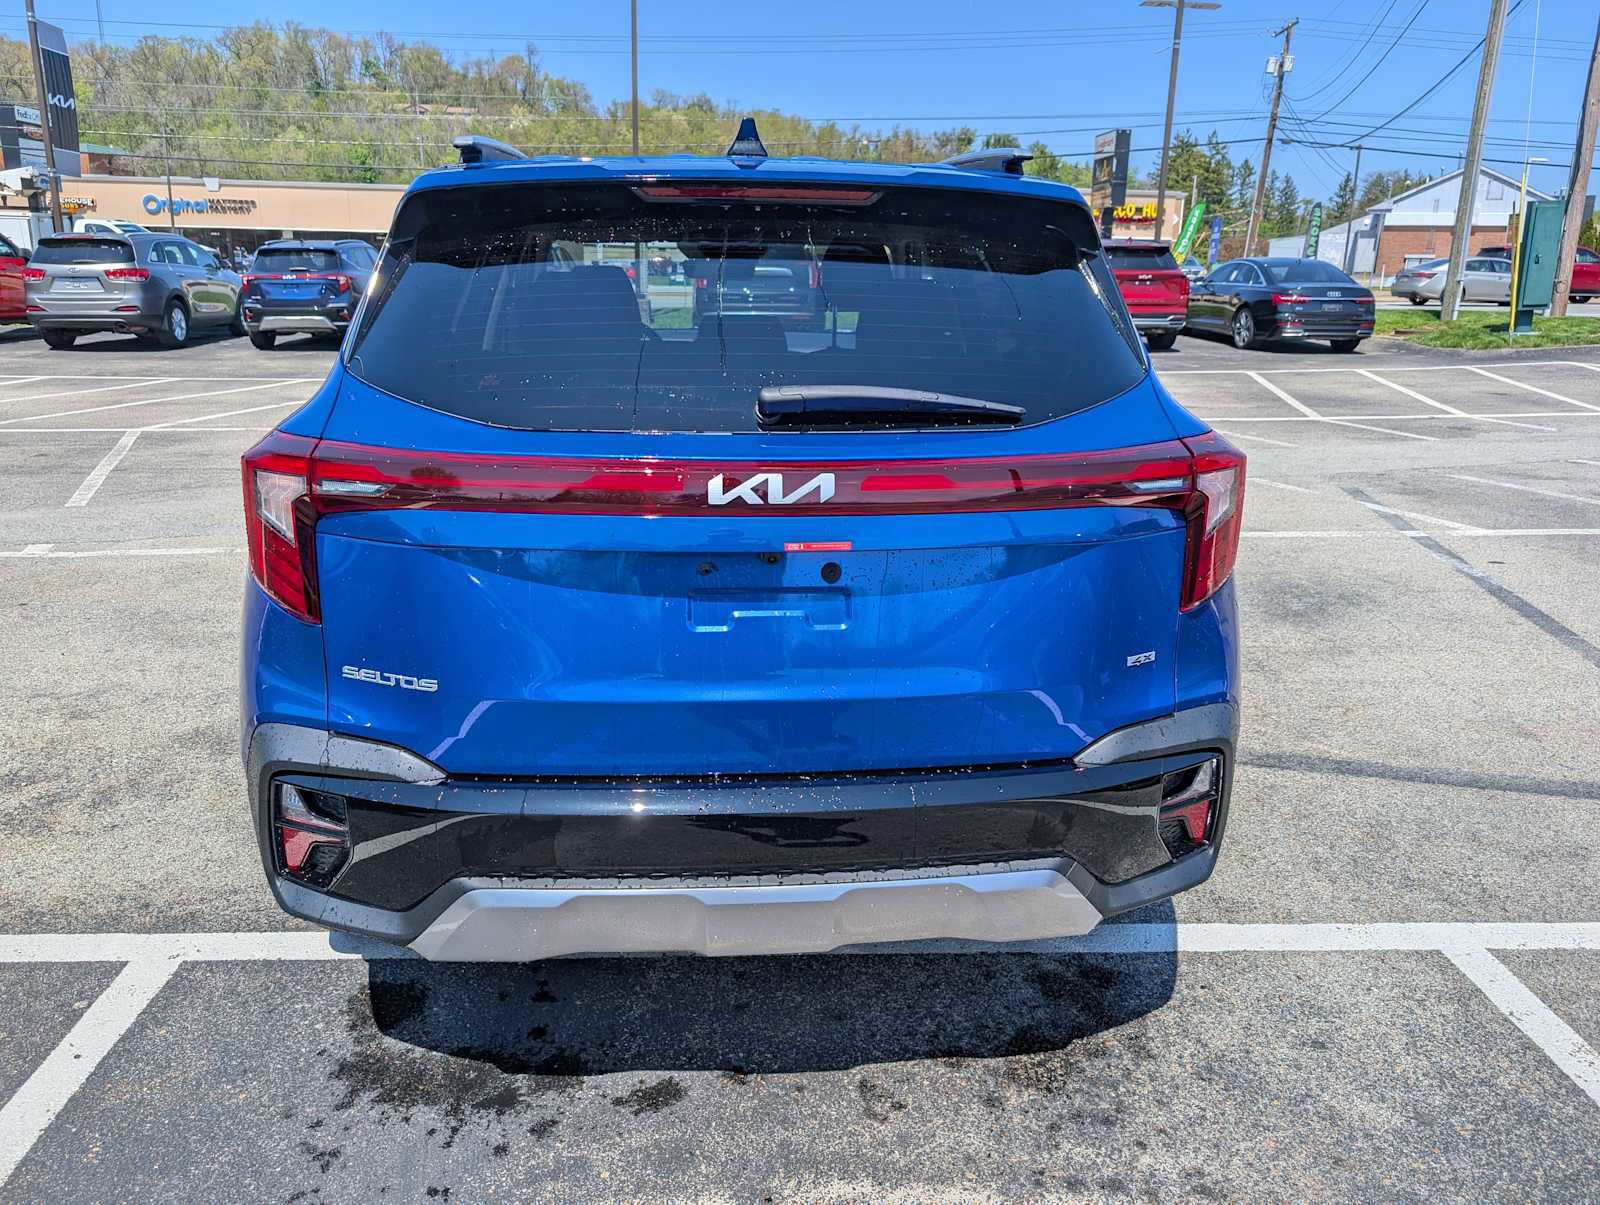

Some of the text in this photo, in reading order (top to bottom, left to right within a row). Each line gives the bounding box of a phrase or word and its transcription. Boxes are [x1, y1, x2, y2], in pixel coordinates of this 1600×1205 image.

[48, 93, 75, 110] KIA
[142, 193, 209, 217] Original
[707, 472, 836, 505] KIA
[341, 665, 439, 693] SELTOS
